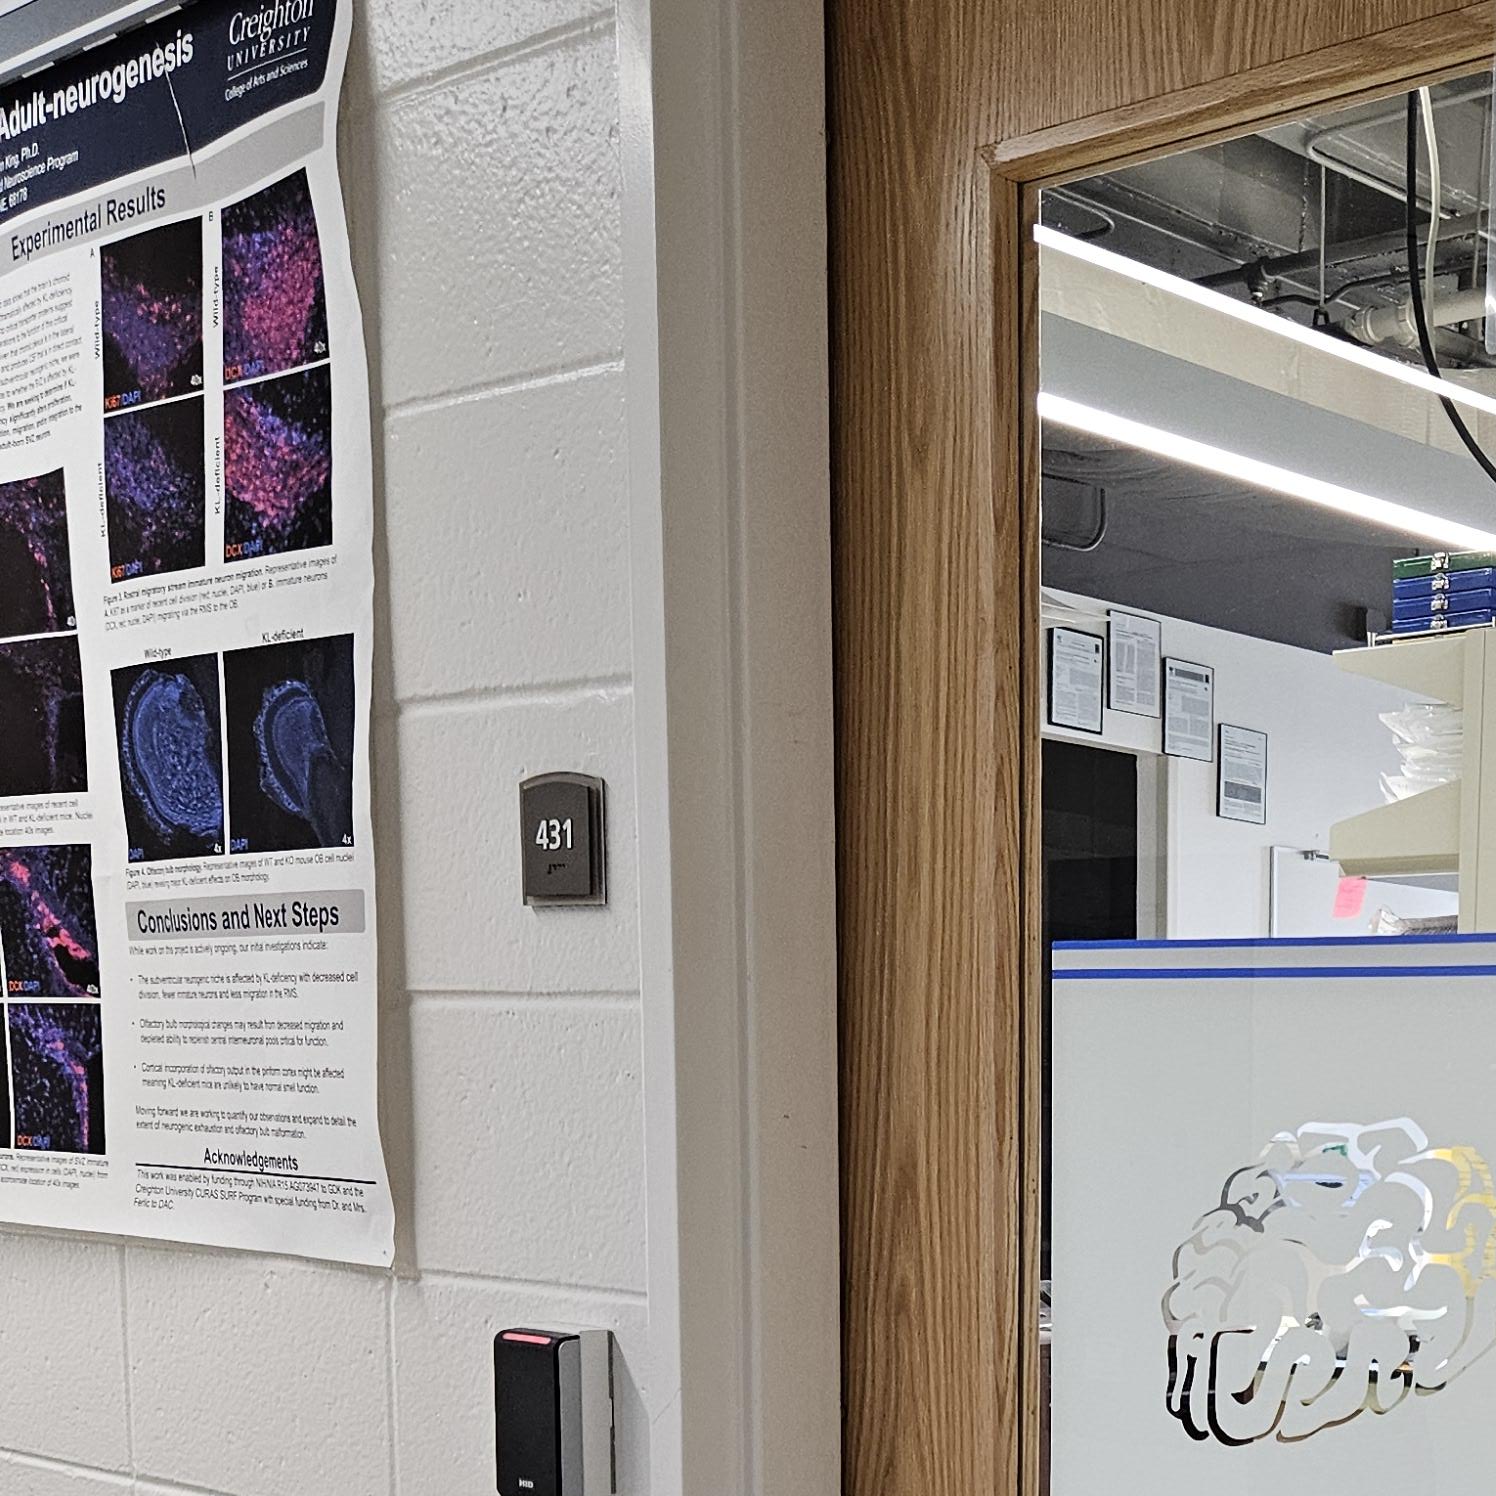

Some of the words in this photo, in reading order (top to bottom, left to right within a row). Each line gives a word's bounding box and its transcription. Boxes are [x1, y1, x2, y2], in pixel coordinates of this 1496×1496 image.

[229, 0, 313, 45] Creighton
[227, 26, 311, 71] UNIVERSITY
[0, 29, 194, 140] Adult-neurogenesis
[11, 204, 101, 261] Experimental
[107, 186, 166, 225] Results
[535, 818, 572, 850] 431
[137, 907, 217, 934] Conclusions
[222, 904, 250, 930] and
[254, 902, 287, 928] Next
[292, 901, 339, 933] Steps
[203, 1148, 299, 1173] Acknowledgements
